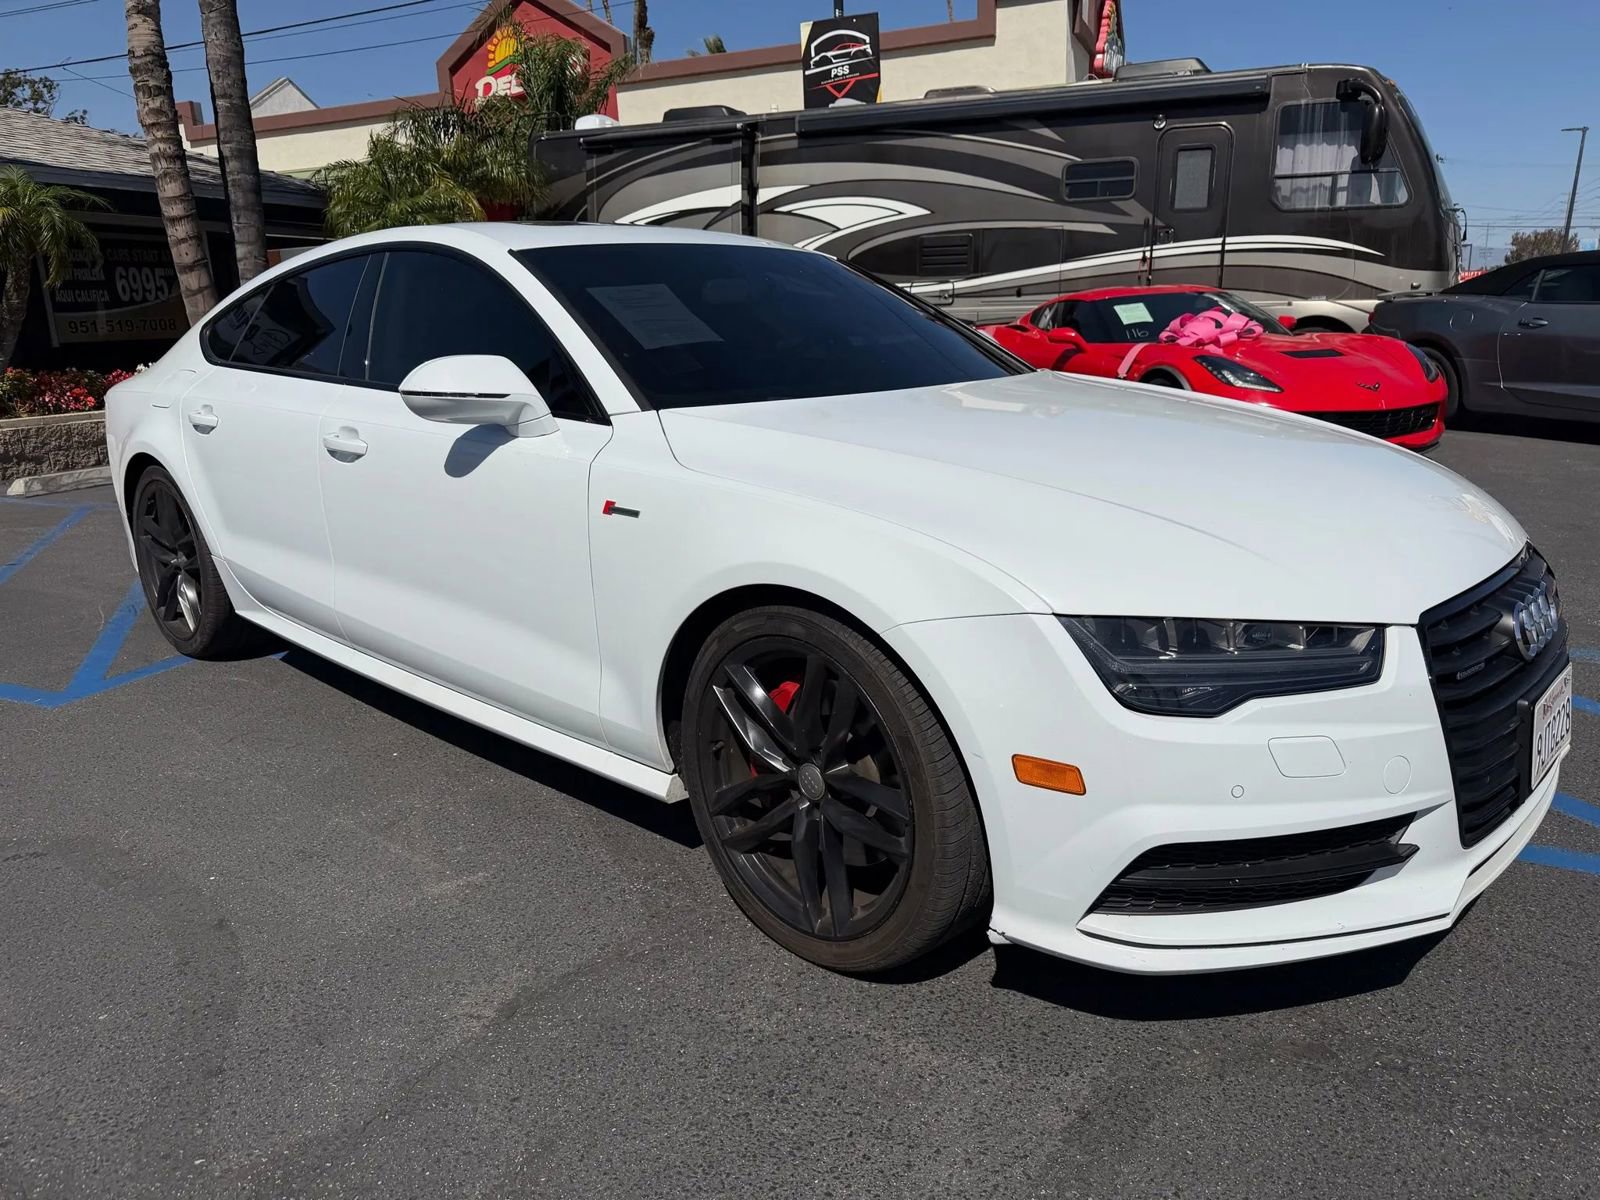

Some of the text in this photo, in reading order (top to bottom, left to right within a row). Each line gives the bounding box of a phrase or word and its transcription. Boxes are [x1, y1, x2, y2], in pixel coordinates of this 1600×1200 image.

[831, 65, 850, 78] PSS
[475, 73, 524, 98] DEL
[114, 266, 169, 302] 6995
[55, 288, 110, 303] AQUI CALIFICA
[68, 318, 177, 334] 951-519-7008
[1125, 328, 1149, 340] 116
